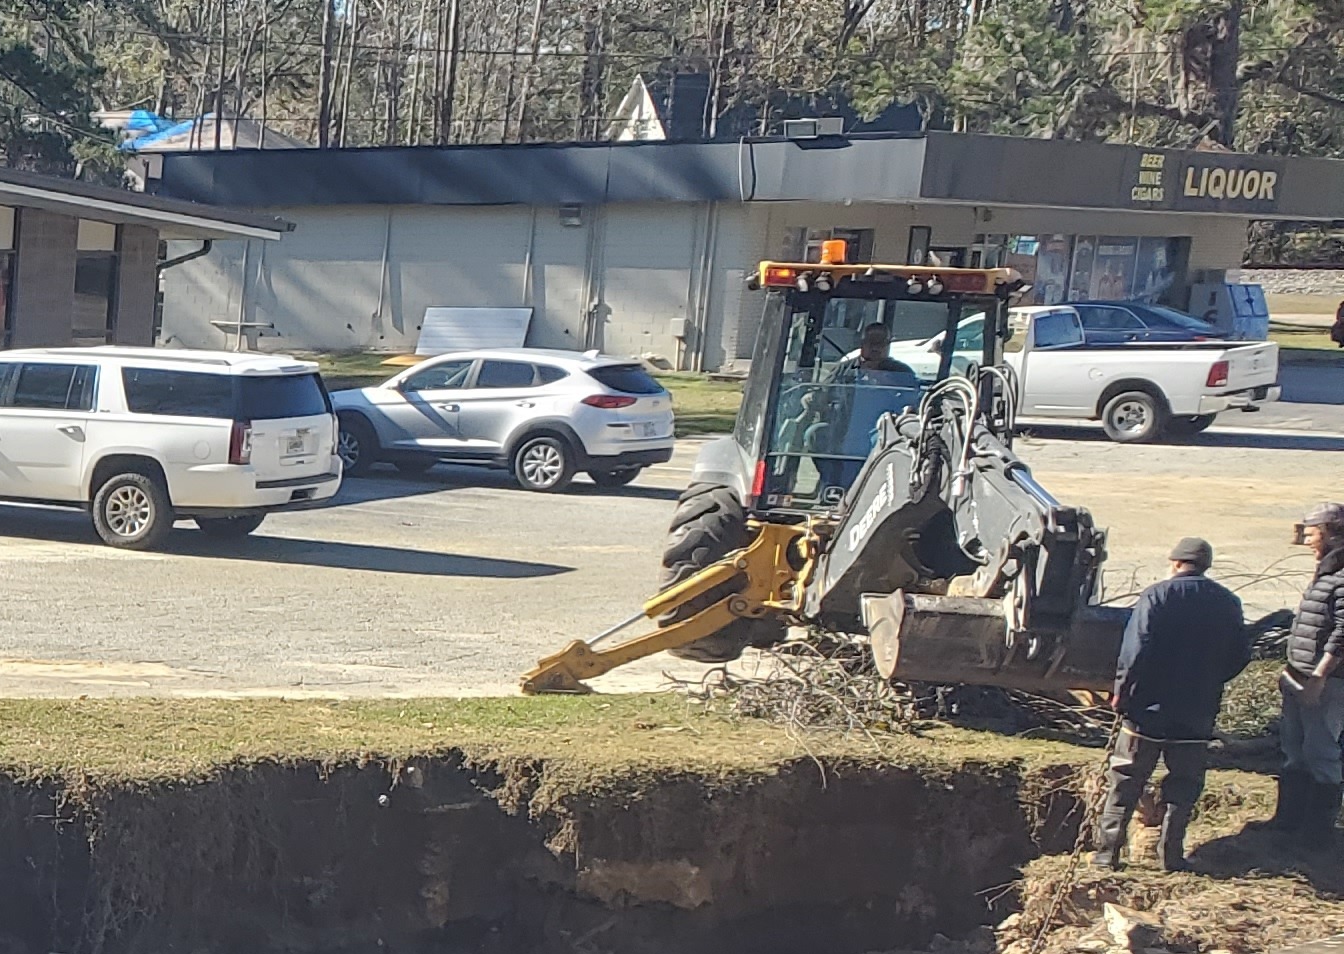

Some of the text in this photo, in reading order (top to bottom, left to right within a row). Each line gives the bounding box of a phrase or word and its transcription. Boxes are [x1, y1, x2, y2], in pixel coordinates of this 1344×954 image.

[1140, 153, 1165, 168] BEER
[1138, 171, 1163, 185] WINE
[1183, 166, 1278, 201] LIQUOR
[1131, 186, 1165, 201] CIGARS
[848, 482, 889, 552] DEERE
